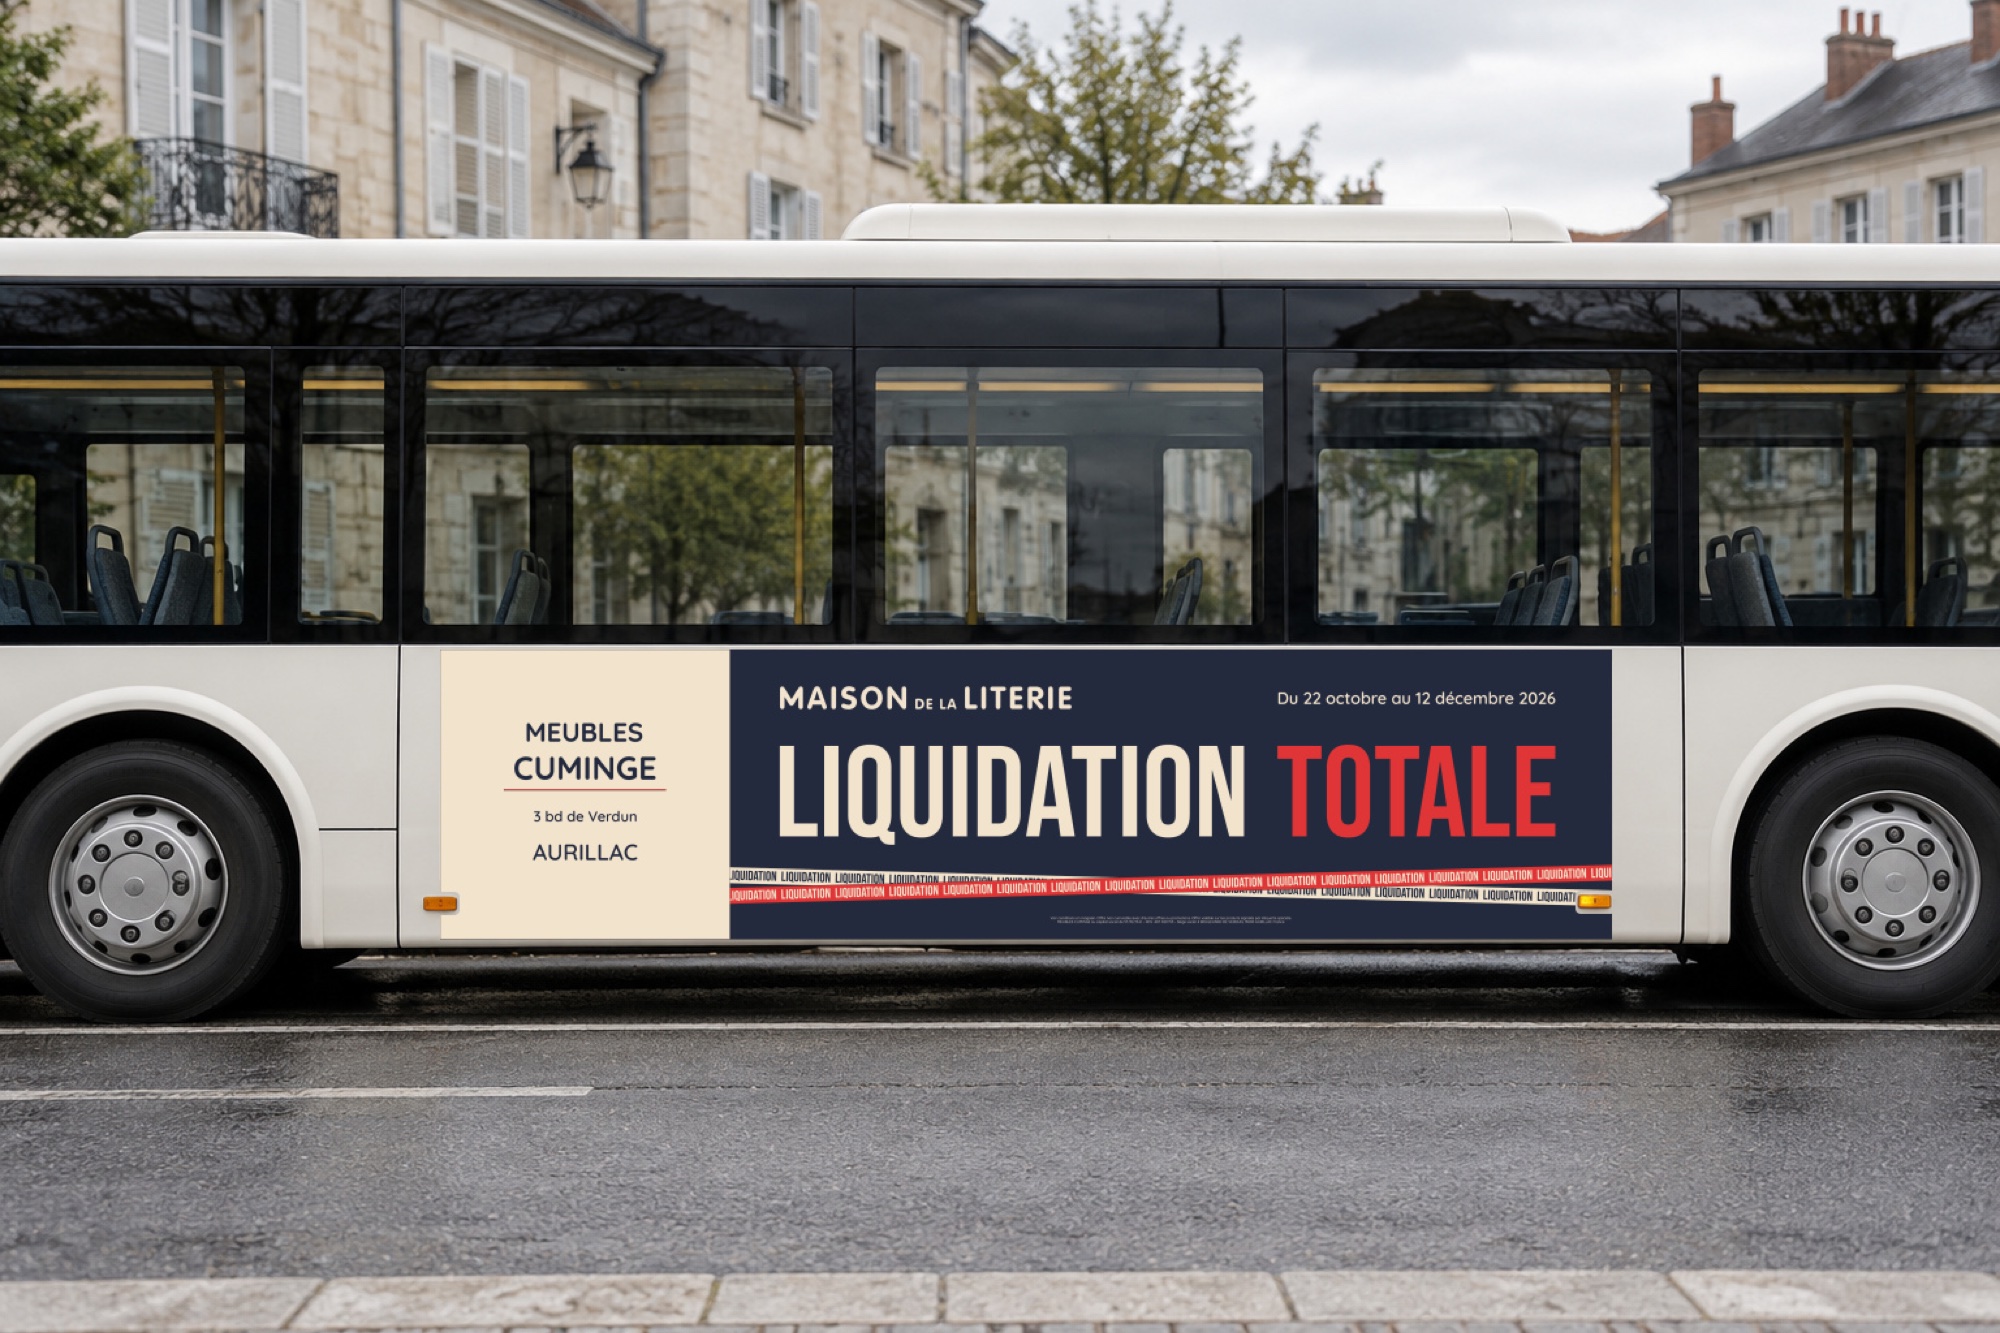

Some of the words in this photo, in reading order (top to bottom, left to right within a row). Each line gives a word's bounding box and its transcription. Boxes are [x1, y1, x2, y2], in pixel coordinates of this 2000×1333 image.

[779, 686, 907, 710] MAISON
[914, 698, 934, 710] DE
[939, 698, 958, 710] LA
[964, 686, 1073, 710] LITERIE
[1277, 691, 1299, 705] Du
[1302, 691, 1321, 705] 22
[1326, 690, 1388, 705] octobre
[1391, 694, 1411, 705] au
[1414, 691, 1431, 705] 12
[1434, 690, 1515, 705] décembre
[1519, 691, 1557, 705] 2026
[525, 722, 644, 742] MEUBLES
[513, 756, 657, 780] CUMINGE
[779, 743, 1246, 846] LIQUIDATION
[1276, 743, 1557, 839] TOTALE
[533, 810, 542, 823] 3
[545, 810, 564, 823] bd
[566, 810, 585, 823] de
[588, 810, 638, 823] Verdun
[532, 844, 639, 861] AURILLAC
[781, 871, 831, 883] LIQUIDATION
[835, 872, 885, 884] LIQUIDATION
[889, 874, 939, 884] LIQUIDATION
[781, 888, 831, 900] LIQUIDATION
[835, 887, 885, 899] LIQUIDATION
[889, 885, 939, 897] LIQUIDATION
[943, 884, 993, 895] LIQUIDATION
[997, 882, 1047, 894] LIQUIDATION
[1051, 881, 1101, 893] LIQUIDATION
[1105, 880, 1155, 892] LIQUIDATION
[1159, 878, 1209, 890] LIQUIDATION
[1213, 876, 1262, 889] LIQUIDATION
[1267, 875, 1316, 887] LIQUIDATION
[1321, 873, 1371, 886] LIQUIDATION
[1375, 872, 1425, 885] LIQUIDATION
[1429, 871, 1479, 883] LIQUIDATION
[1483, 869, 1533, 882] LIQUIDATION
[1537, 868, 1587, 880] LIQUIDATION
[1321, 888, 1370, 897] LIQUIDATION
[1375, 887, 1425, 898] LIQUIDATION
[1429, 888, 1479, 900] LIQUIDATION
[1483, 890, 1533, 901] LIQUIDATION
[1537, 891, 1576, 902] LIQUIDATI
